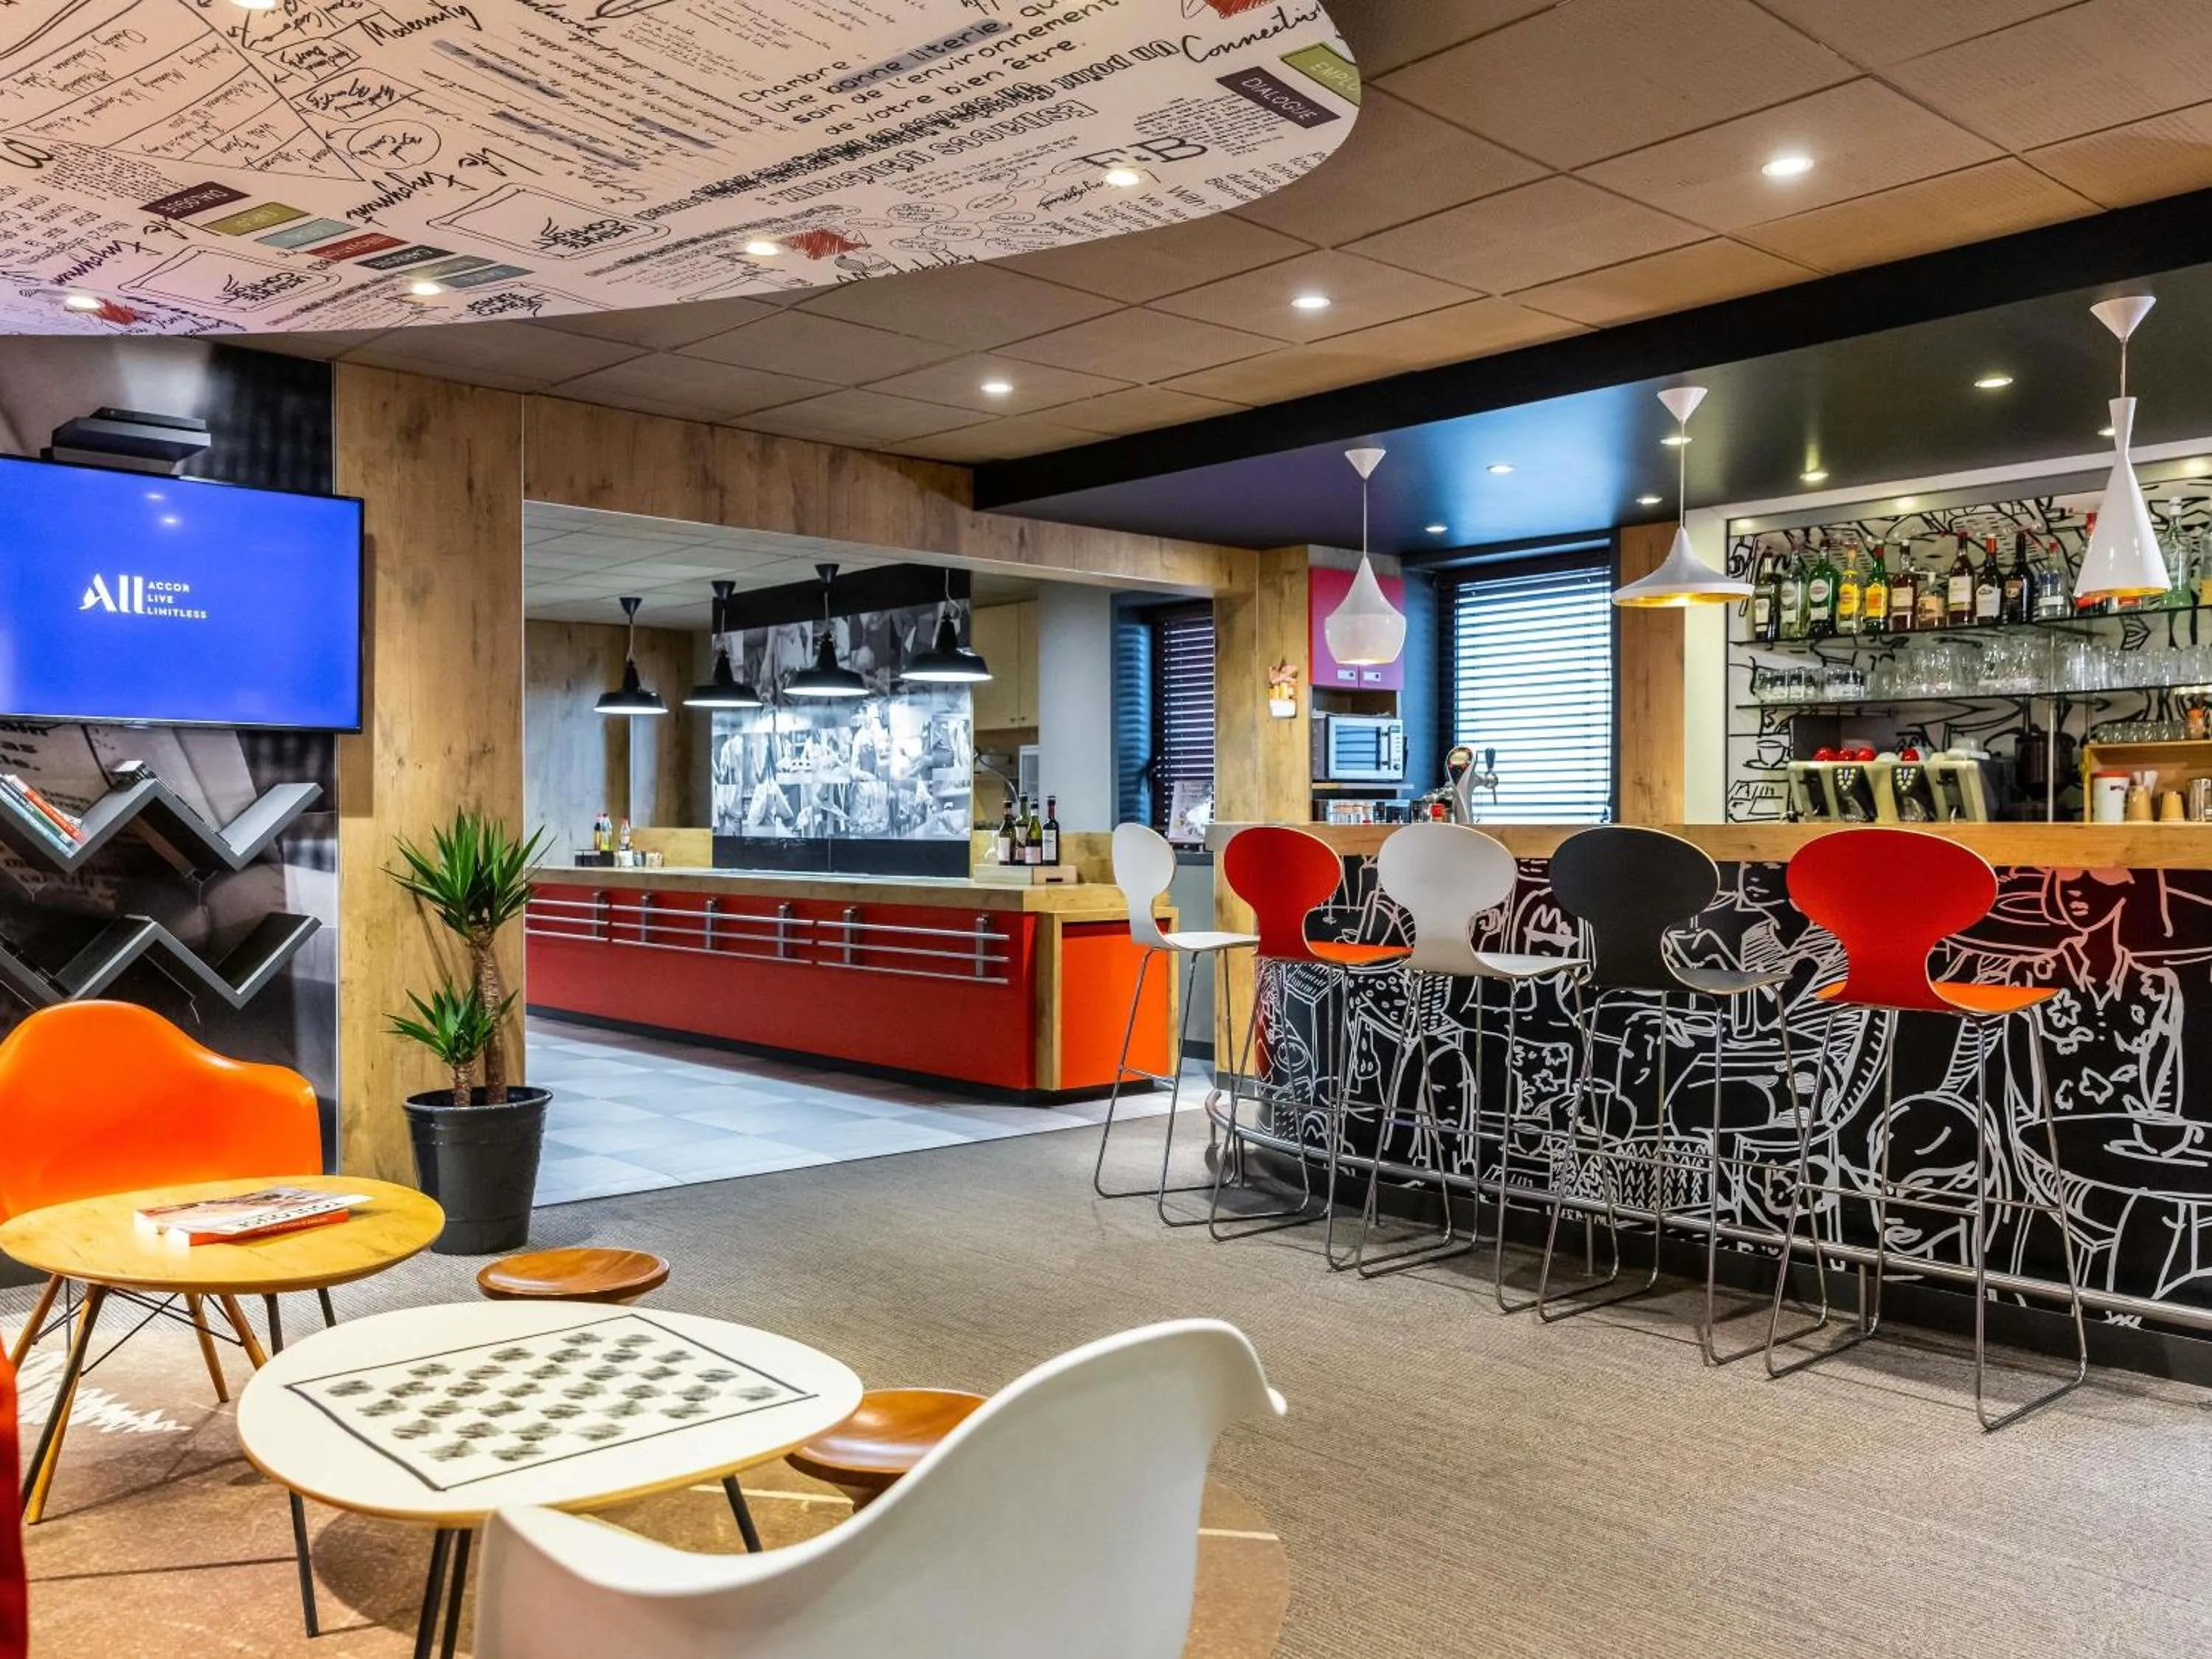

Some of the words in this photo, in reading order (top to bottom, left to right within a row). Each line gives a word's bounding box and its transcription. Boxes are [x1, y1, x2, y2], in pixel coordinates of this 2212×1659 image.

[359, 0, 482, 46] Modernity
[738, 60, 851, 103] Chambre
[765, 92, 817, 113] Une
[818, 60, 904, 95] bonne
[908, 21, 1013, 62] literie,
[793, 102, 846, 124] soin
[851, 89, 883, 104] de
[886, 0, 1119, 89] l'environnement
[825, 121, 856, 136] de
[853, 94, 935, 124] votre
[940, 69, 1005, 95] bien
[1242, 77, 1318, 120] DIALOGUE
[148, 581, 189, 593] ACCOR
[148, 594, 173, 604] LIVE
[147, 607, 206, 619] LIMITLESS
